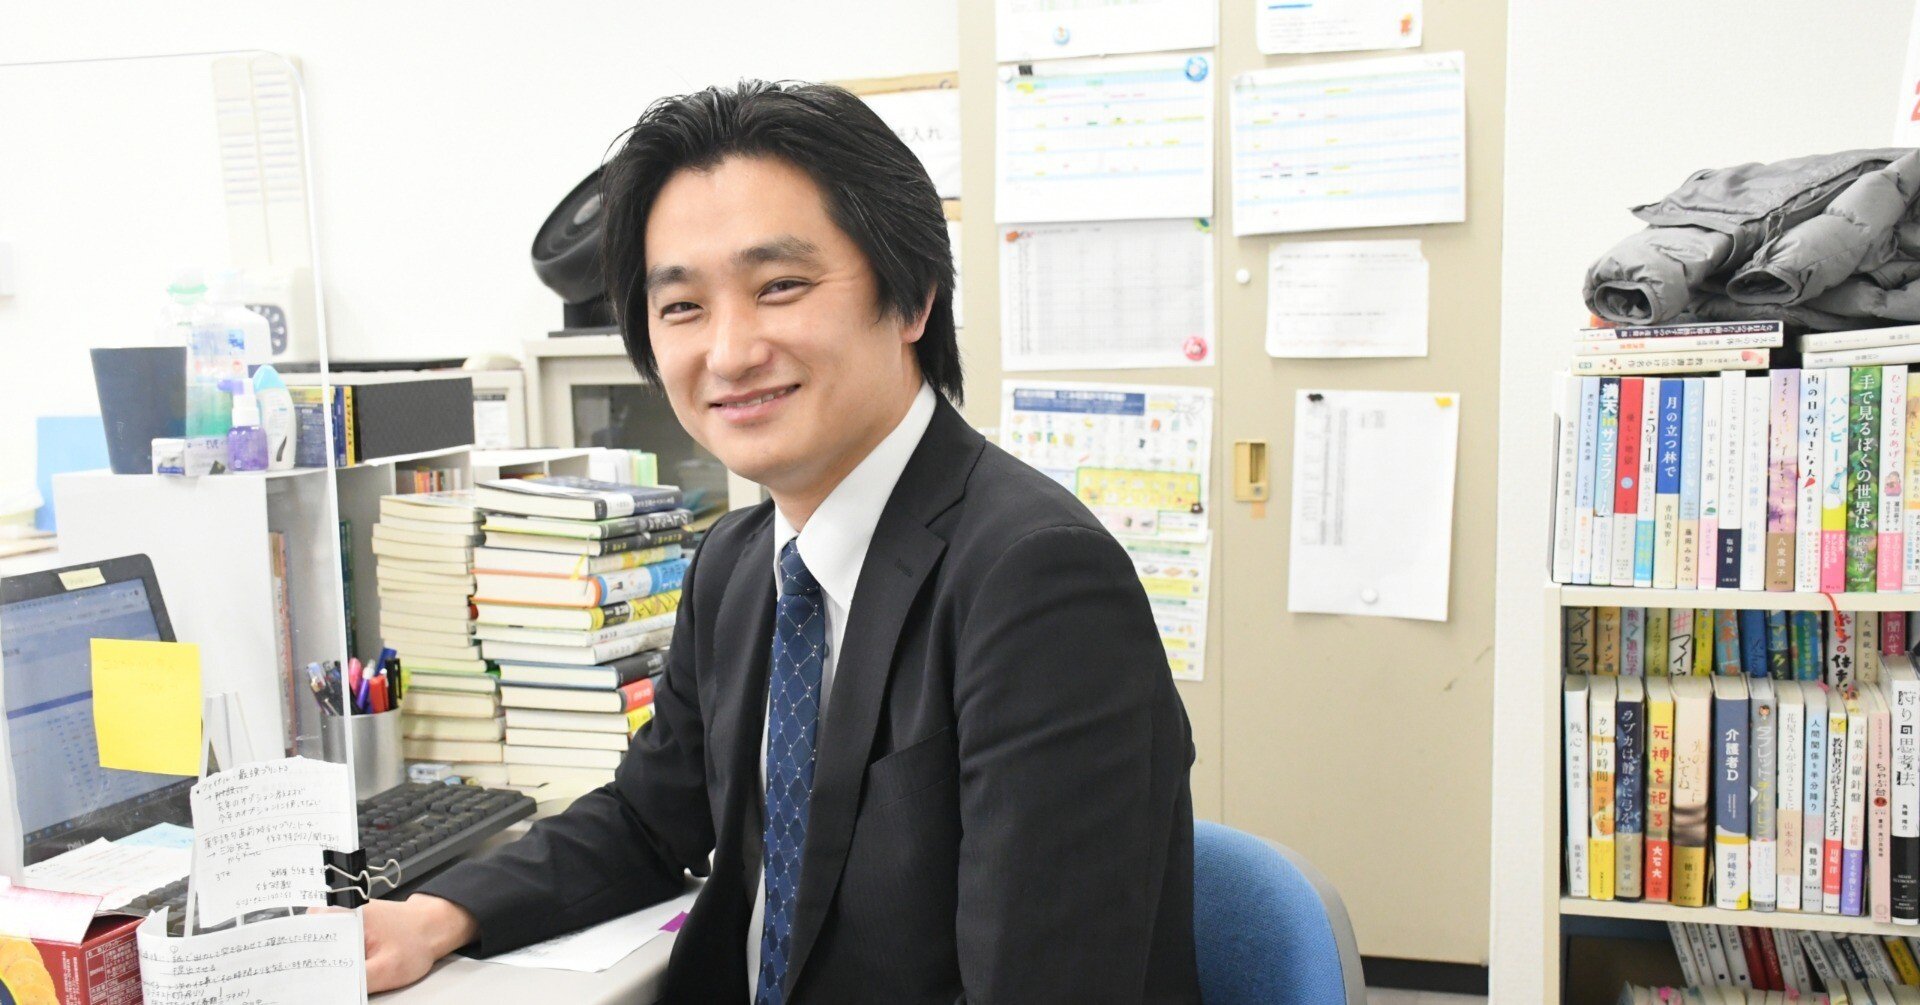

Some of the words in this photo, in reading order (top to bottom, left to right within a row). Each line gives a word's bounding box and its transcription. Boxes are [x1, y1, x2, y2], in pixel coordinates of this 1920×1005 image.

[1602, 383, 1620, 414] 満天
[1661, 396, 1678, 478] 月の立つ林で
[1854, 374, 1875, 528] 手で見るぼくの世界は
[1776, 538, 1787, 577] 八束澄子
[1570, 607, 1592, 676] マイブラ
[1569, 722, 1582, 748] 残心
[1596, 717, 1609, 783] カレーの時間
[1725, 728, 1739, 782] 介護者D
[1850, 727, 1864, 804] 言葉の羅針盤
[1621, 709, 1636, 842] ラブカは静かに弓を持つ
[1651, 725, 1670, 828] 死神を祀る
[1830, 737, 1844, 837] 教科書の詩をよみかえす
[1874, 762, 1888, 797] ちゃぶ台
[1651, 846, 1663, 880] 大石大
